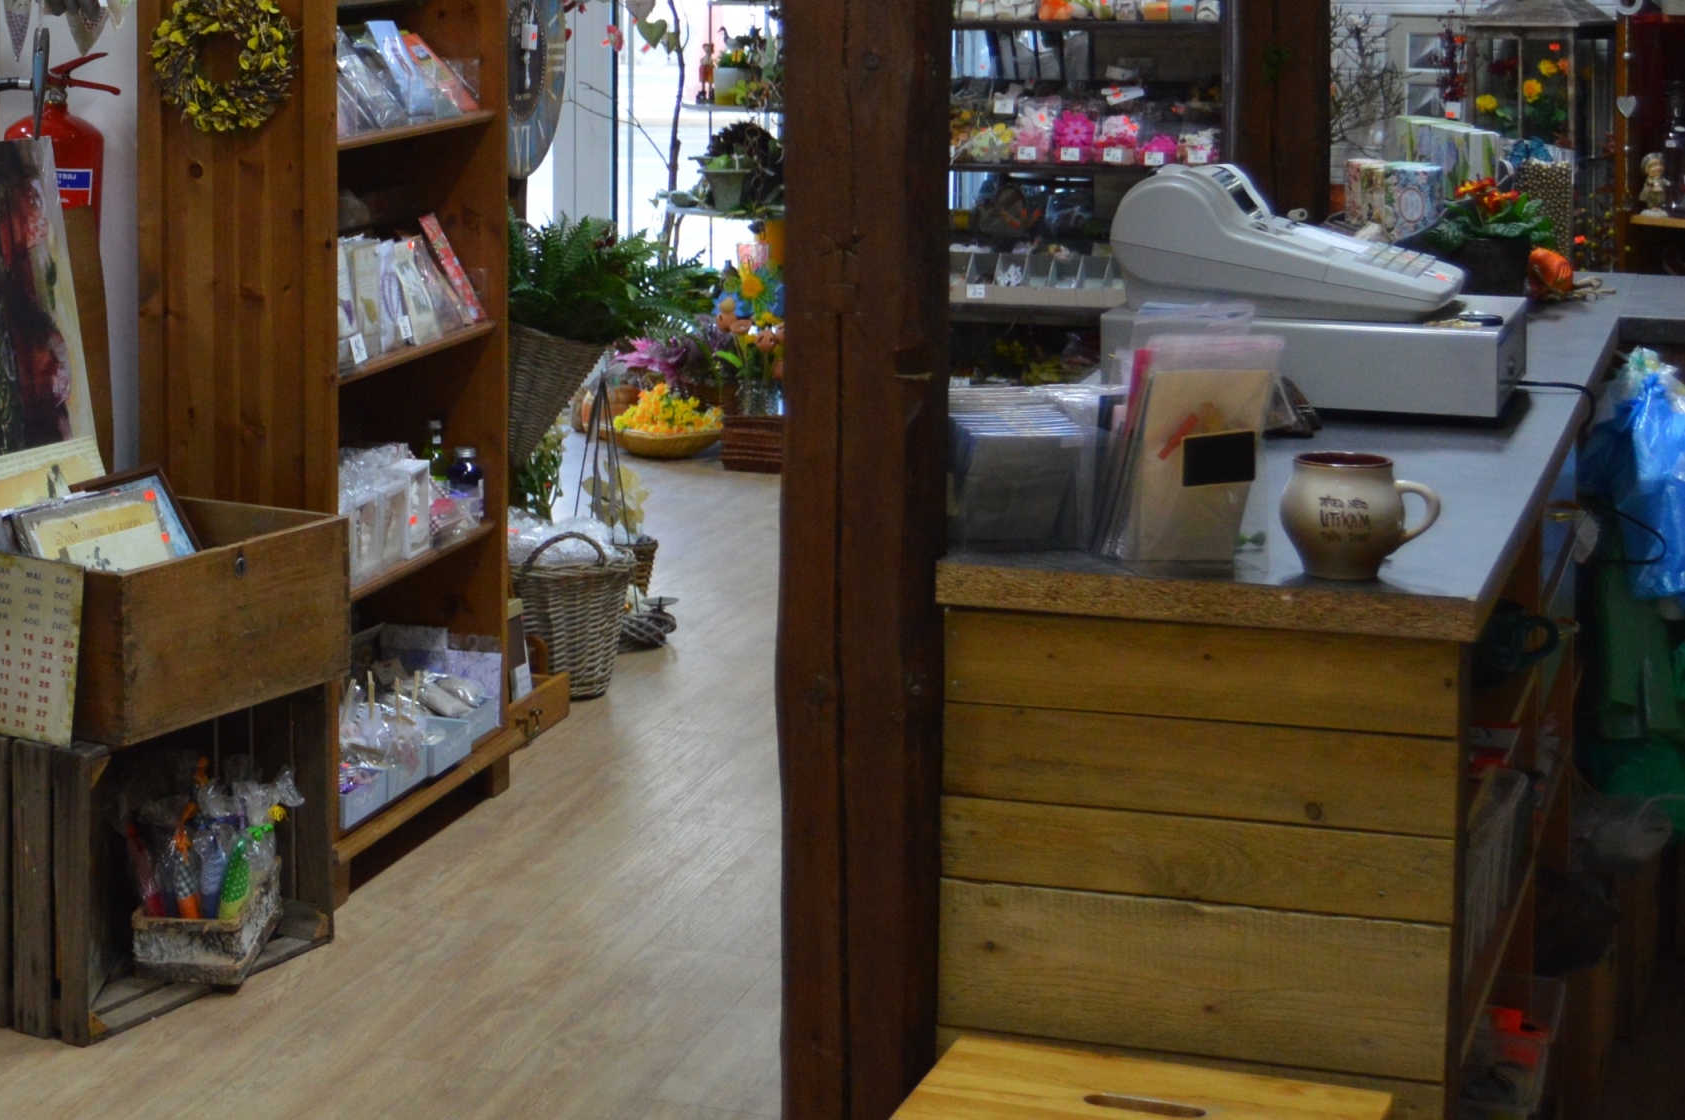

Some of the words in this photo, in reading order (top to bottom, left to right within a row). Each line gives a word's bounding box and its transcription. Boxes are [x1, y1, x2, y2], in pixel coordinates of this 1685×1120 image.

[23, 633, 34, 641] 15
[42, 636, 54, 645] 22
[63, 640, 75, 648] 29
[22, 648, 33, 656] 16
[41, 651, 53, 660] 23
[62, 655, 73, 663] 30
[0, 658, 11, 666] 10
[20, 662, 31, 670] 17
[40, 666, 51, 674] 24
[60, 670, 71, 678] 31
[0, 673, 10, 681] 11
[19, 677, 30, 685] 18
[39, 681, 50, 689] 25
[18, 691, 28, 699] 19
[37, 695, 48, 703] 26
[16, 706, 27, 714] 20
[36, 710, 47, 718] 27
[15, 720, 25, 728] 21
[35, 724, 45, 732] 28
